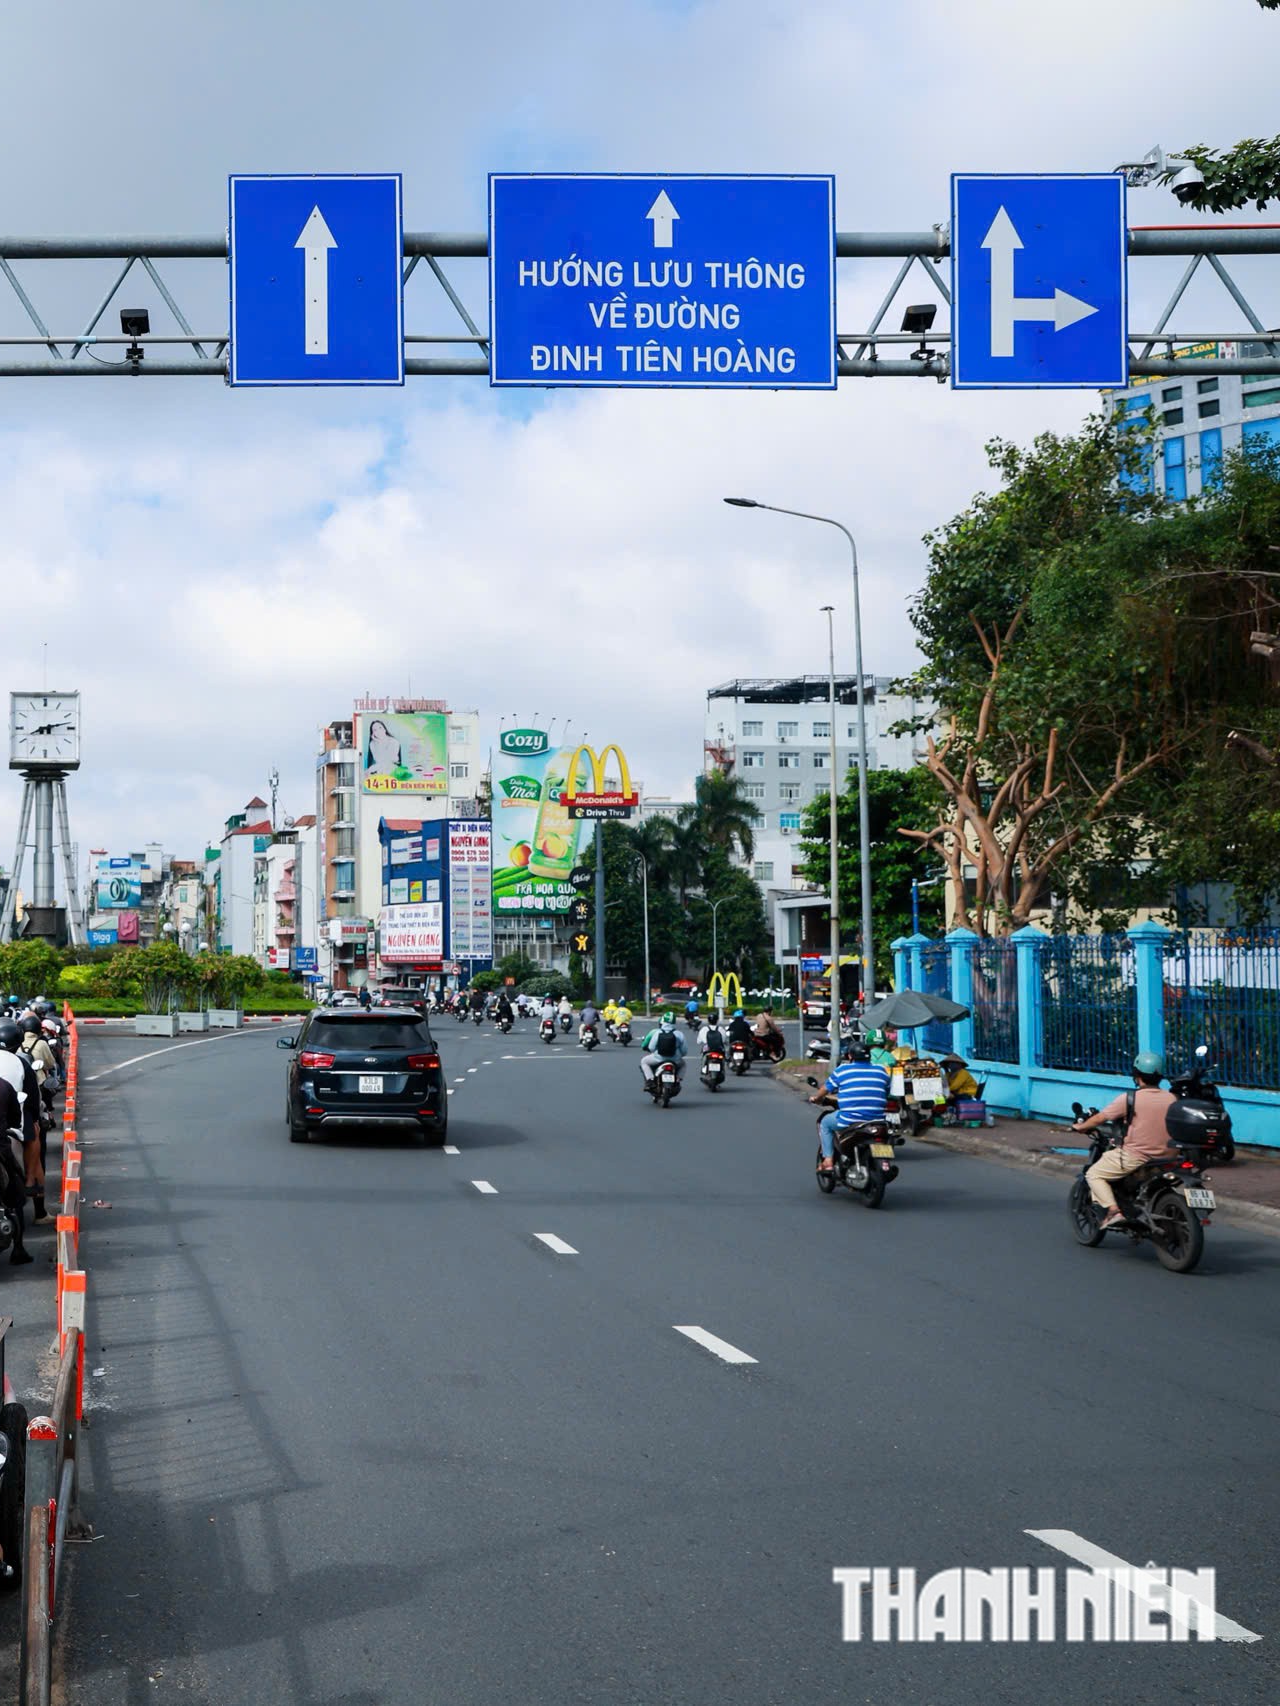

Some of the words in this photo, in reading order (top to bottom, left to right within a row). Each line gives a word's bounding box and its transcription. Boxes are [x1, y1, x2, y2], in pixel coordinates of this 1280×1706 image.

[519, 254, 623, 288] HƯỚNG
[633, 261, 694, 289] LƯU
[704, 253, 805, 290] THÔNG
[589, 291, 627, 330] VỀ
[634, 295, 740, 330] ĐƯỜNG
[531, 345, 603, 373] ĐINH
[615, 339, 684, 373] TIÊN
[693, 341, 796, 374] HOÀNG
[504, 732, 544, 751] Cozy
[366, 779, 397, 790] 14-16
[575, 797, 624, 805] McDonald's
[586, 808, 607, 817] Drive
[608, 809, 625, 817] Thru
